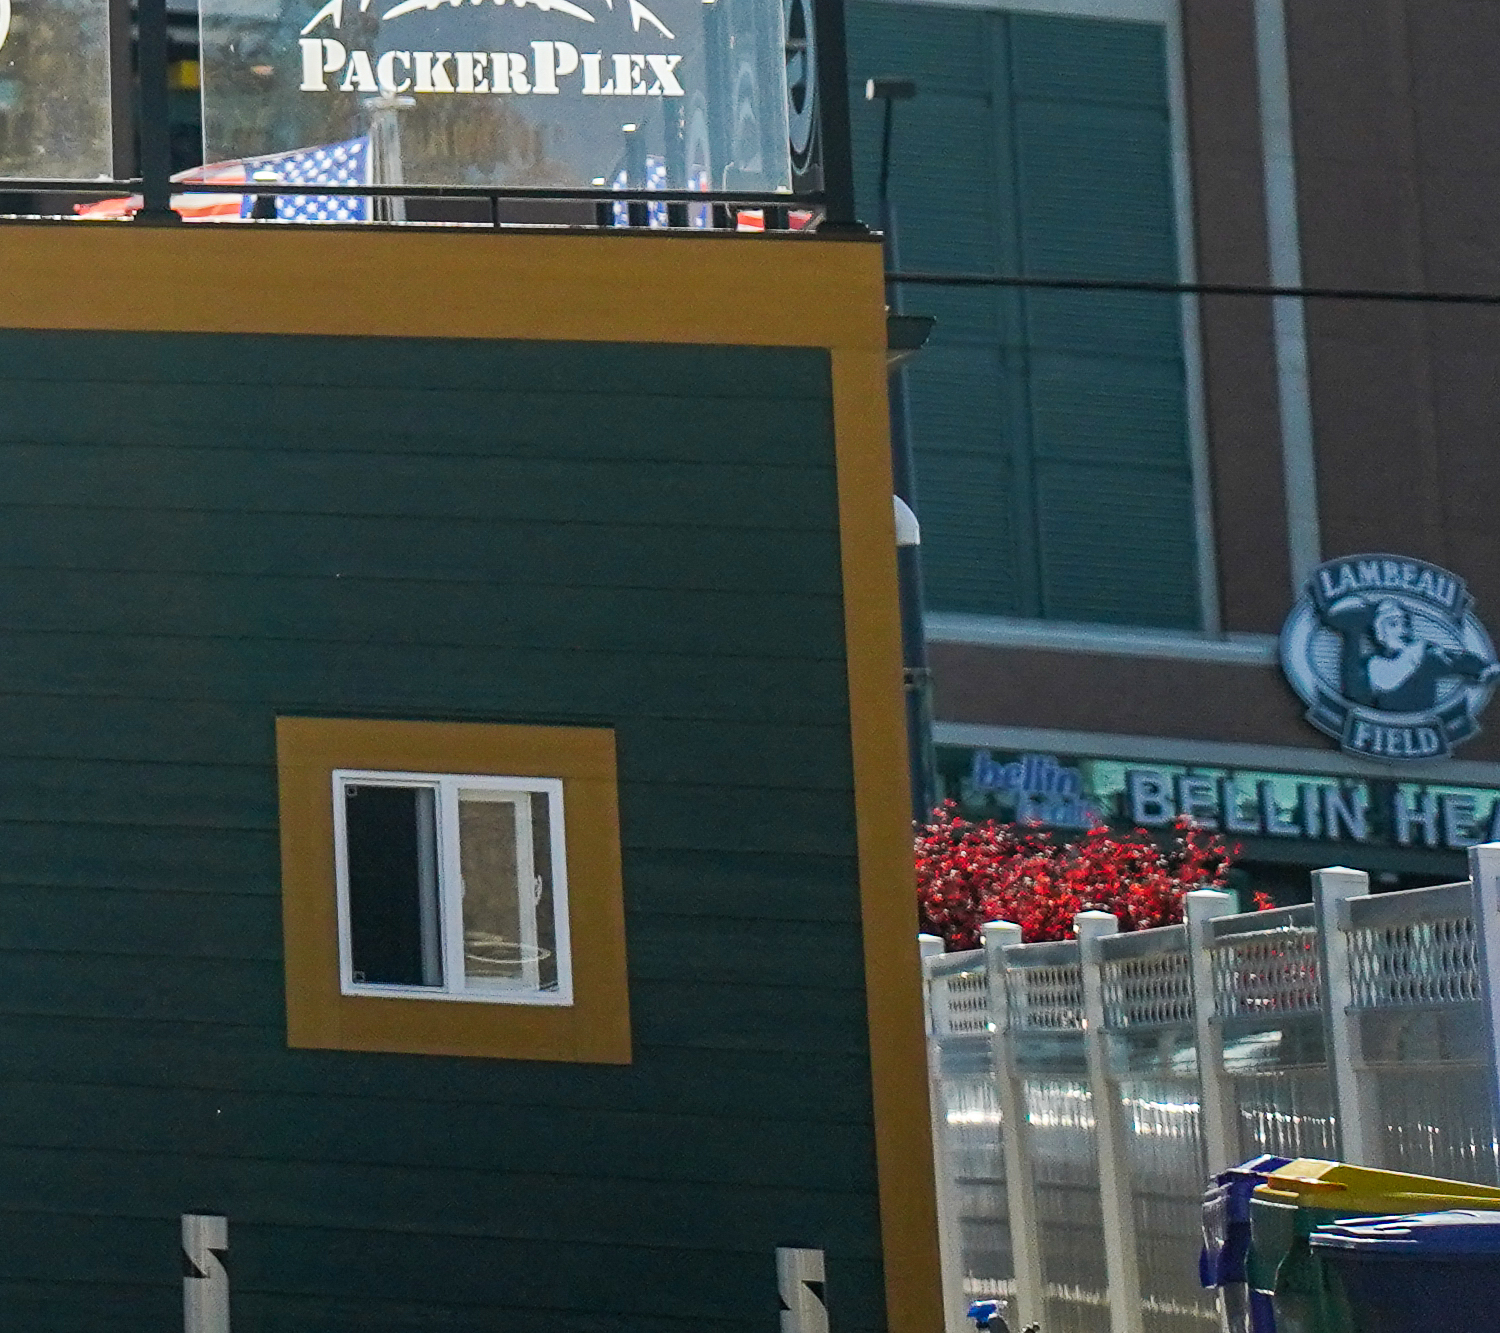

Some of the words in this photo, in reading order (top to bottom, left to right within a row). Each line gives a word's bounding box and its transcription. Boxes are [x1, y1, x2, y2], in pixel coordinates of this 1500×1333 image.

[1319, 559, 1458, 607] LAMBEAU
[1353, 719, 1440, 756] FIELD
[1127, 769, 1368, 842] BELLIN
[1395, 790, 1500, 847] HE
